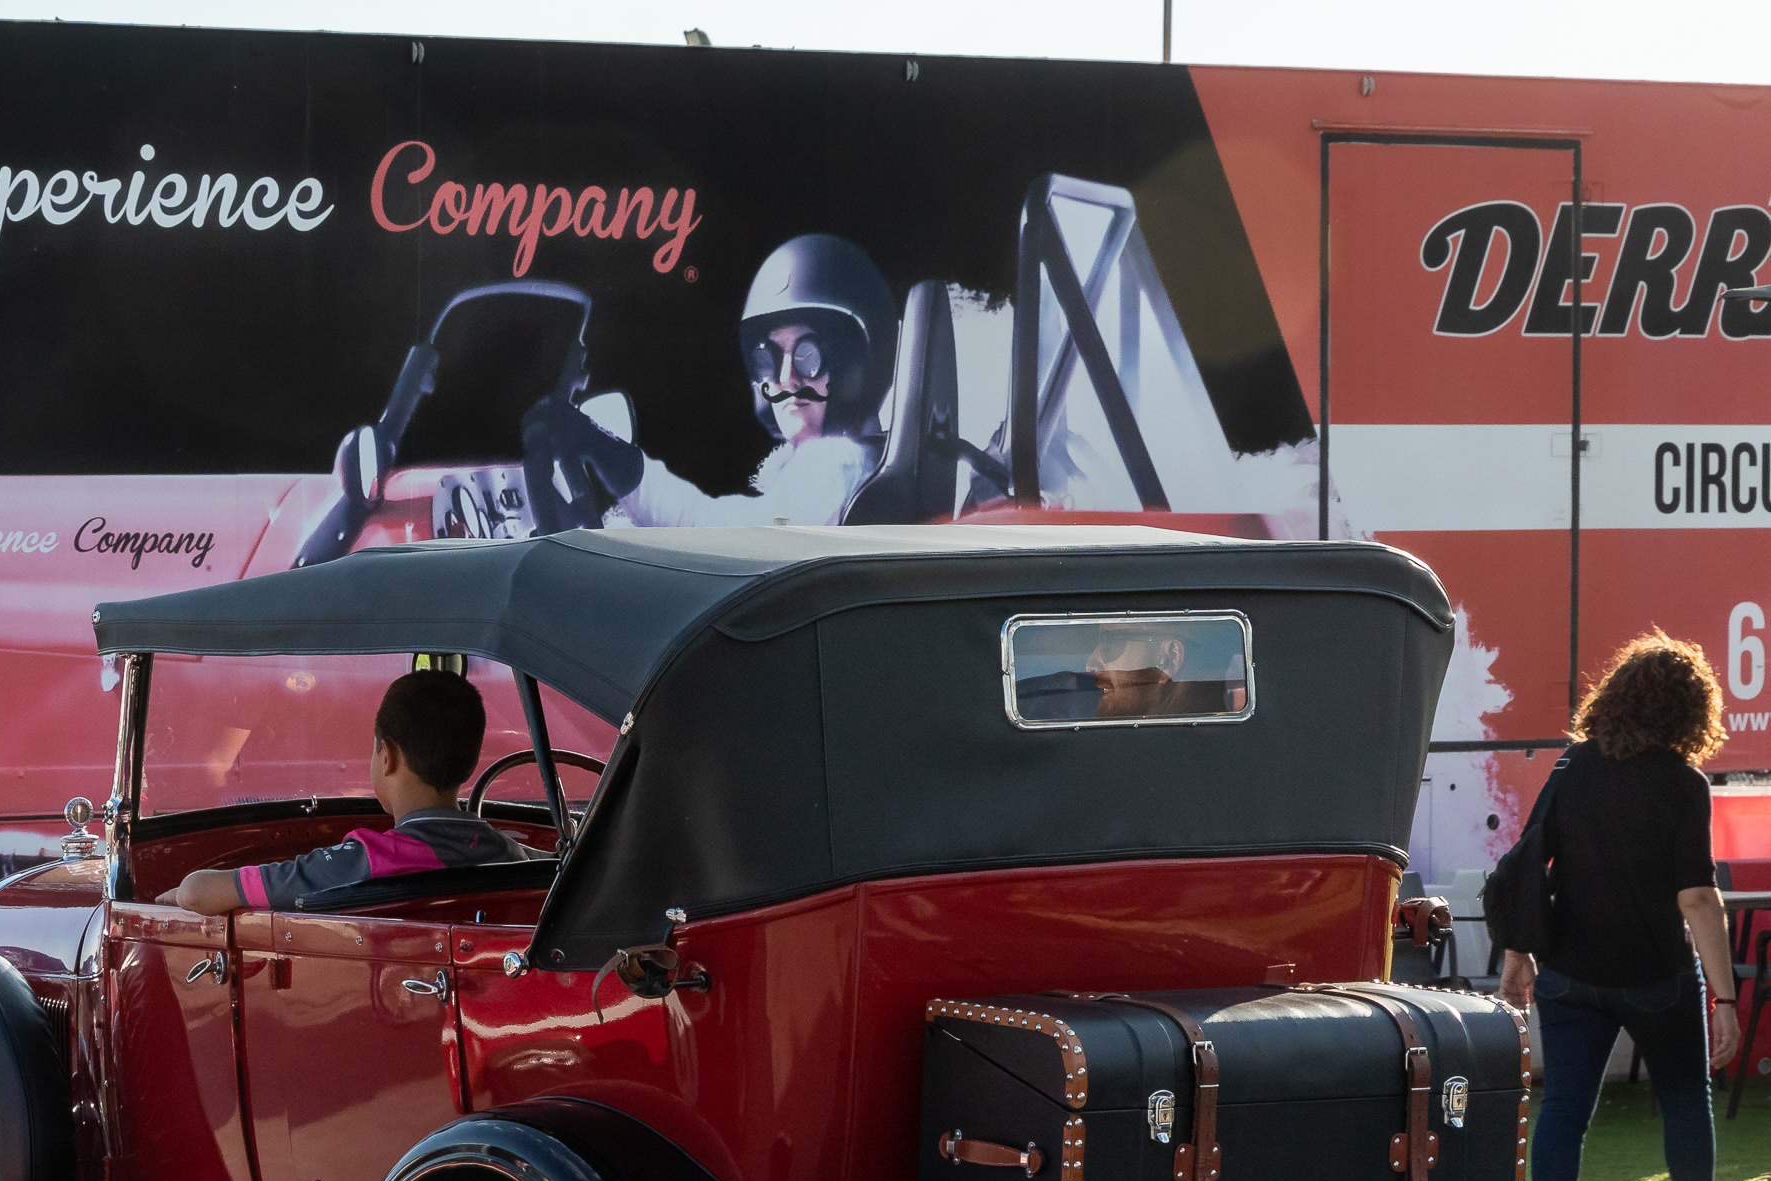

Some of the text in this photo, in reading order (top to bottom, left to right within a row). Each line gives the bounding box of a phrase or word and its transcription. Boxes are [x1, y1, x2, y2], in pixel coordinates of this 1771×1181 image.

[370, 141, 702, 277] Company
[1420, 200, 1771, 342] DERR
[74, 516, 215, 570] Company
